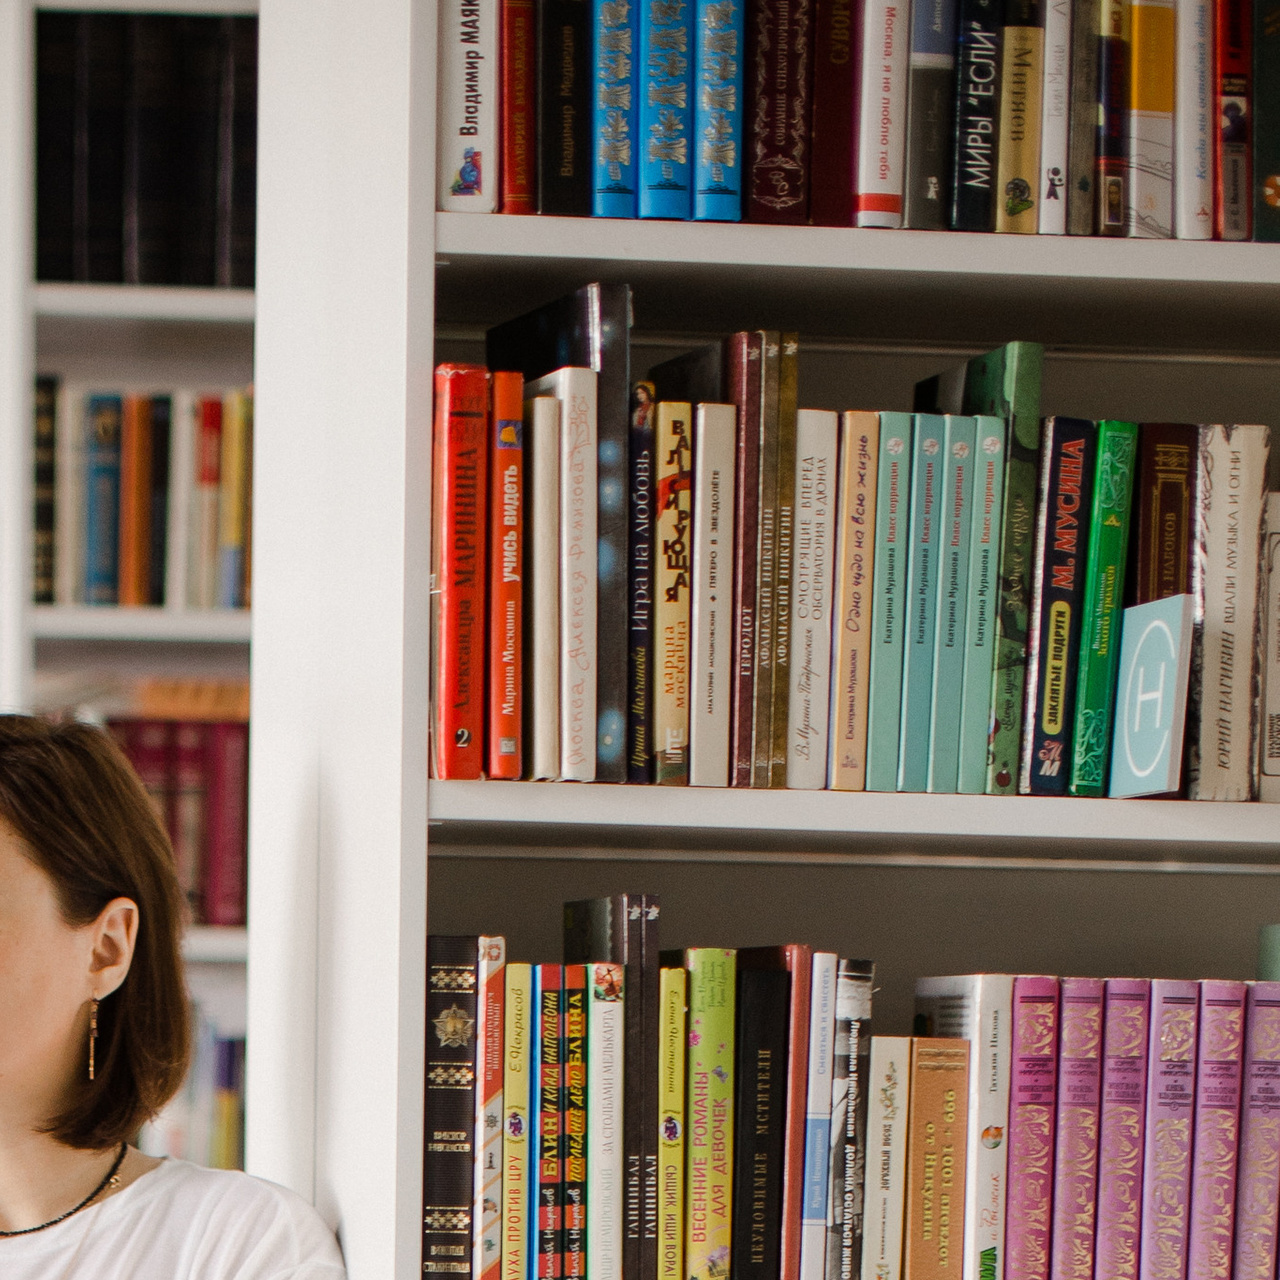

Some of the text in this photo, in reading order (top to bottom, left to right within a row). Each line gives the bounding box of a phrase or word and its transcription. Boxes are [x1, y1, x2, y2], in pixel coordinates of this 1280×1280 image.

[458, 50, 484, 137] Владимир
[776, 93, 787, 146] СОБРАНИЕ
[878, 6, 896, 180] Москва, я не люблю тебя
[561, 105, 575, 177] Владимир
[963, 116, 992, 188] МИРЫ
[797, 456, 814, 619] СМОТРЯЩИЕ ВПЕРЕД
[1051, 438, 1086, 590] М. МУСИНА
[1163, 512, 1176, 582] НАБОКОВ
[502, 465, 518, 715] Марина Москвина учись видеть
[759, 508, 773, 668] АФАНАСИЙ НИКИТИН
[884, 462, 899, 644] Екатерина Мурашова Класс коррекции
[975, 461, 994, 647] Екатерина Мурашова Класс коррекции
[740, 605, 754, 676] ГЕРОДОТ
[1218, 450, 1241, 769] ЮРИЙ НАГИБИН ВДАЛИ МУЗЫКА И ОГНИ
[1047, 610, 1066, 726] ЗАКЛЯТЫЕ ПОДРУГИ
[1135, 661, 1165, 732] Н
[456, 728, 470, 748] 2
[543, 992, 558, 1064] НАПОЛЕОНА
[569, 992, 583, 1067] БЛИНА
[848, 1020, 861, 1072] Людмила
[543, 1067, 559, 1101] КЛАД
[544, 1102, 557, 1114] И
[569, 1070, 584, 1107] ДЕЛО
[509, 1154, 522, 1181] ЦРУ
[542, 1116, 558, 1176] БЛИН
[569, 1108, 584, 1182] ПОСЛЕДНЕЕ
[692, 1071, 709, 1243] ВЕСЕННИЕ РОМАНЫ
[712, 1097, 727, 1218] ДЛЯ ДЕВОЧЕК
[751, 1049, 771, 1263] НЕУЛОВИМЫЕ МСТИТЕЛИ
[844, 1144, 856, 1191] ДОЛЖНА
[922, 1120, 937, 1240] от Никулина
[508, 1188, 520, 1242] ПРОТИВ
[627, 1155, 640, 1239] ГАННИБАЛ
[645, 1155, 657, 1239] ГАННИБАЛ
[842, 1191, 855, 1246] ОСТАТЬСЯ
